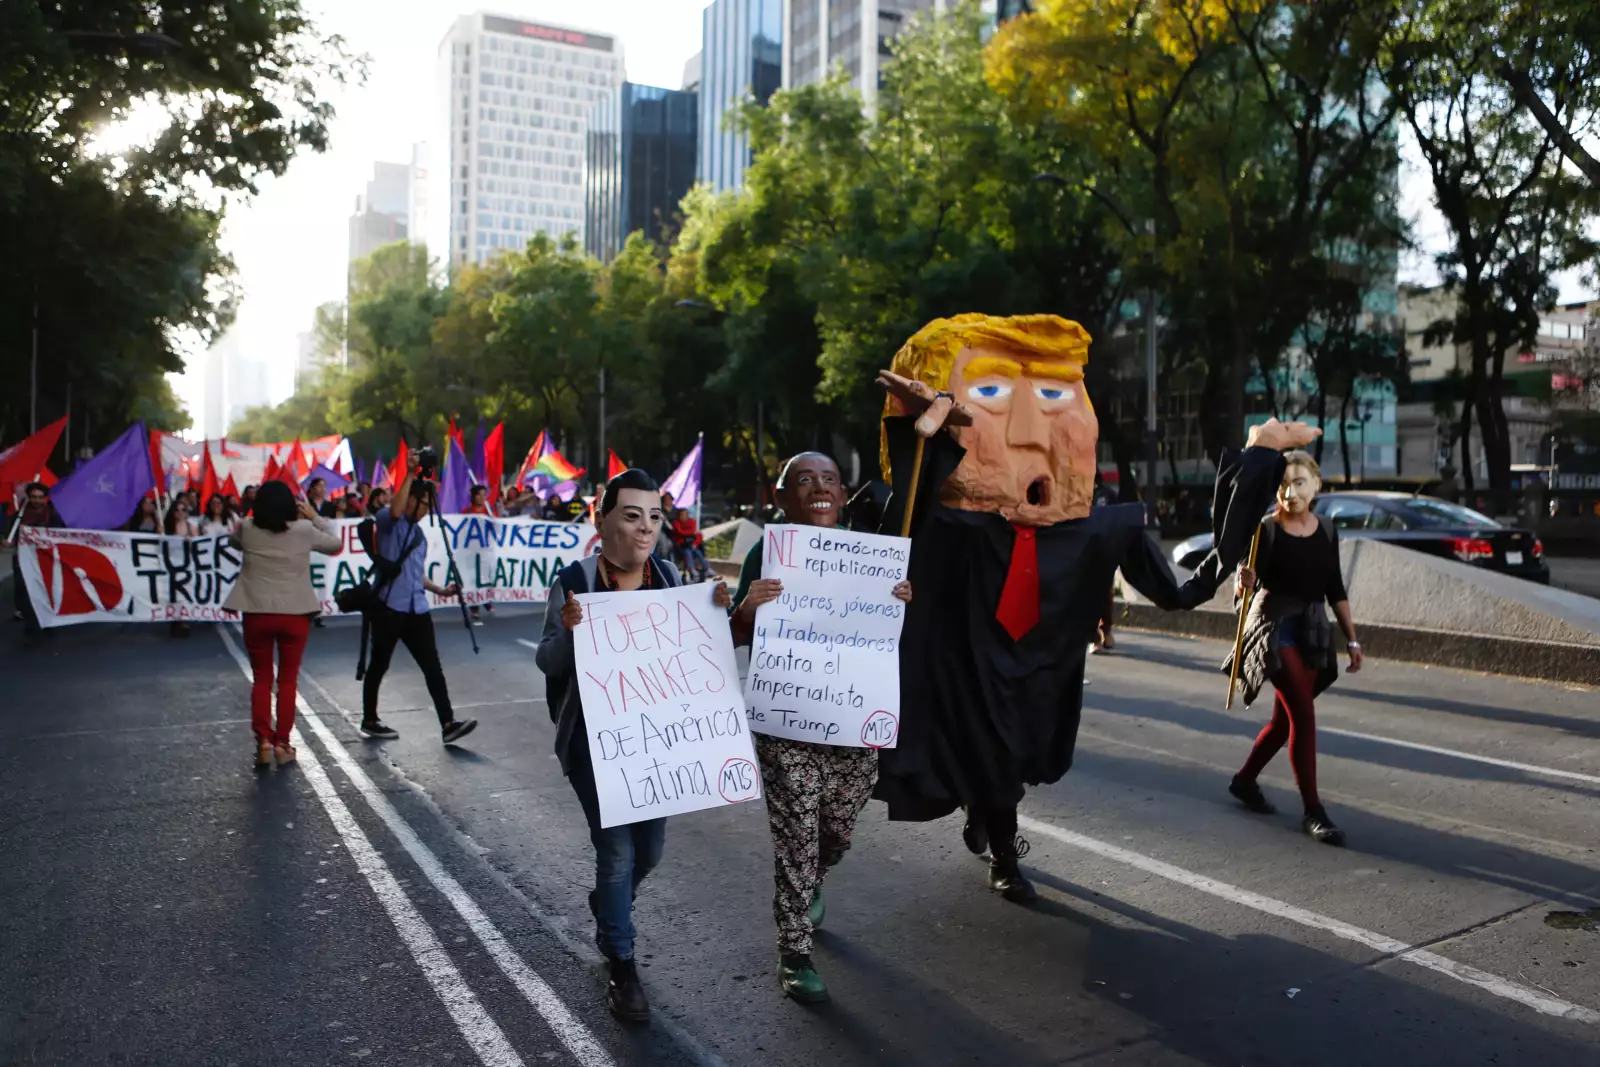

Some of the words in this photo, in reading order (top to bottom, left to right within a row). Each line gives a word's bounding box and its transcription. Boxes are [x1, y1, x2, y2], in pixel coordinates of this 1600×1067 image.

[443, 517, 580, 549] YANKEES
[768, 529, 799, 568] NI
[809, 532, 905, 562] demócratas
[131, 534, 241, 571] FUER
[805, 556, 901, 580] republicanos
[136, 569, 240, 604] TRUM
[475, 553, 566, 588] LATINA
[840, 596, 900, 618] jóvenes
[581, 599, 713, 655] FUERA
[757, 625, 767, 650] y
[773, 618, 895, 652] Trabajadores
[585, 643, 726, 715] YANKES
[756, 648, 812, 673] contra
[824, 653, 840, 675] el
[751, 673, 864, 708] imperialista
[745, 706, 766, 722] de
[770, 709, 840, 741] Trump
[864, 717, 895, 740] MTS
[597, 726, 637, 760] DE
[620, 757, 712, 808] Latina
[722, 762, 752, 793] MTS
